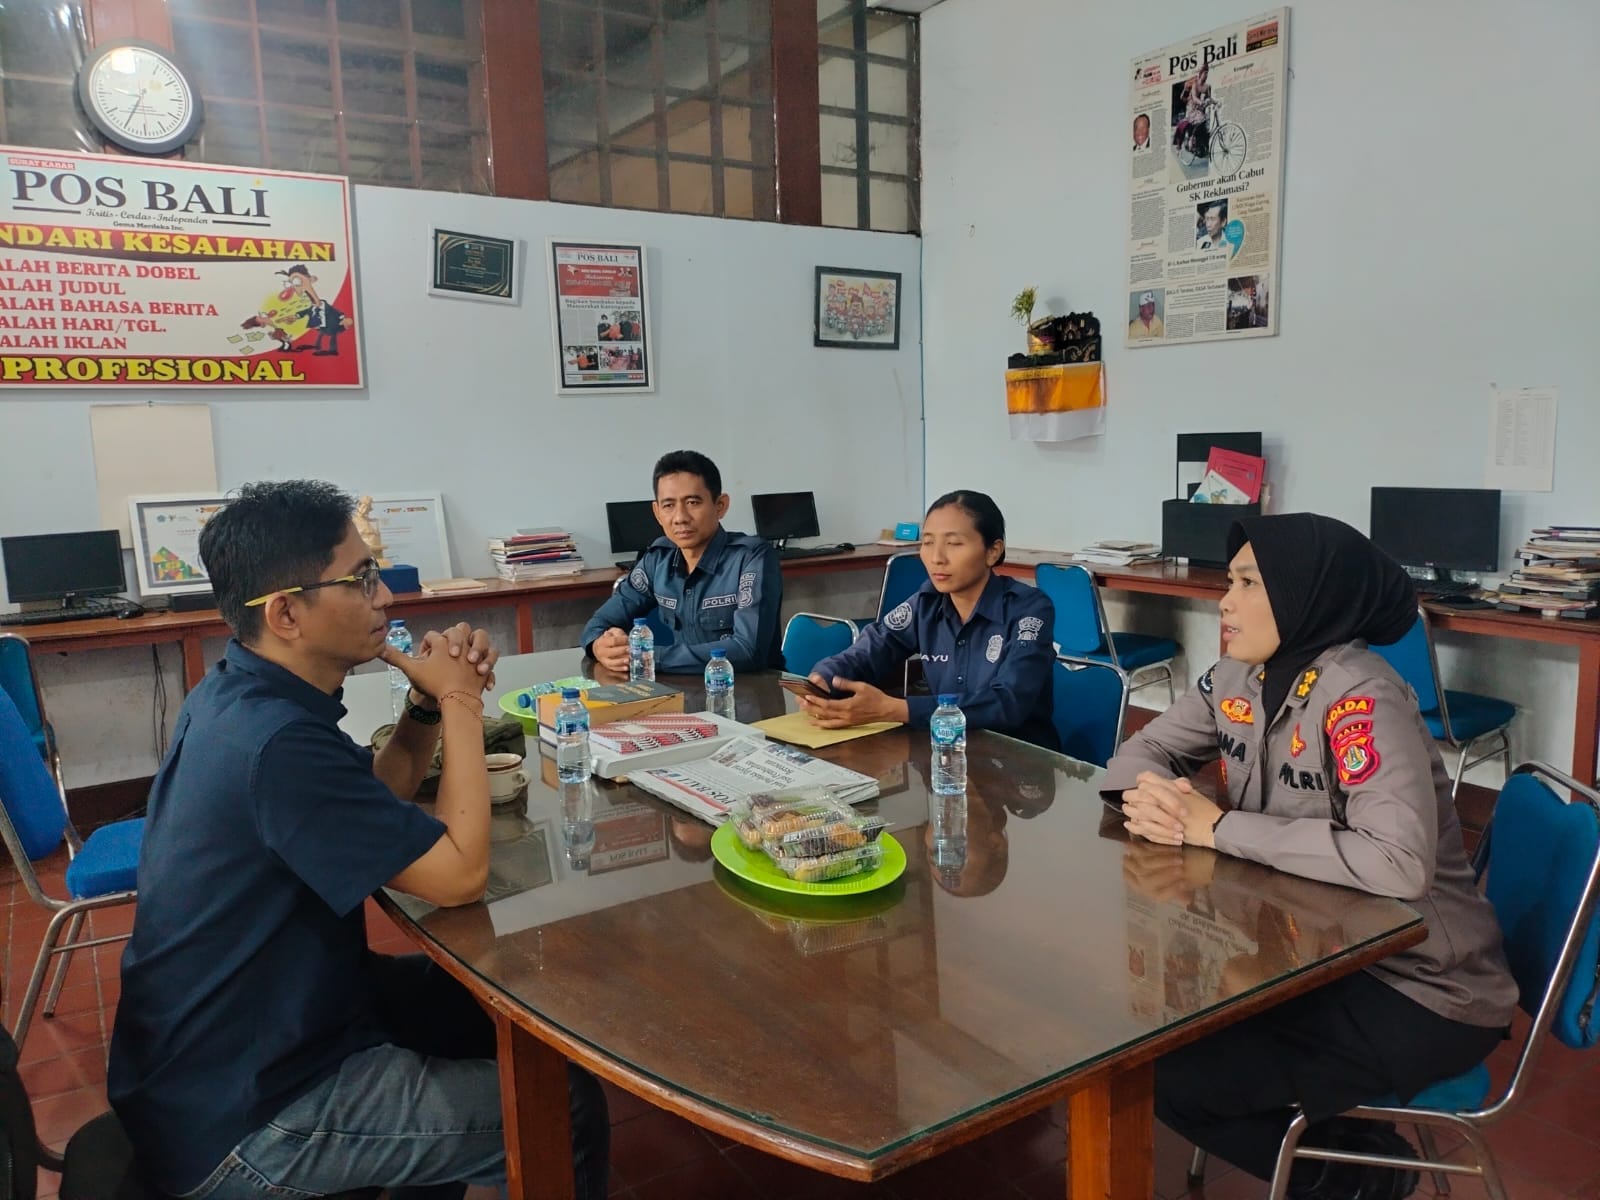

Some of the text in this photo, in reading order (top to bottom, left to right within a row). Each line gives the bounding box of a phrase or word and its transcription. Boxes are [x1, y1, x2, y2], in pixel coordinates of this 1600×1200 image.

[1169, 54, 1198, 76] Pos
[1203, 33, 1238, 64] Bali
[1176, 167, 1265, 193] Gubernur akan Cabut
[10, 169, 271, 217] POS BALI
[1189, 181, 1250, 202] SK Reklamasi?
[122, 231, 332, 262] KESALAHAN
[577, 253, 595, 261] POS
[56, 261, 130, 278] BERITA
[136, 264, 200, 280] DOBEL
[59, 281, 126, 297] JUDUL
[60, 298, 144, 314] BAHASA
[148, 301, 219, 317] BERITA
[62, 317, 167, 333] HARI/TGL.
[64, 336, 127, 350] IKLAN
[0, 355, 305, 382] PROFESIONAL
[704, 596, 735, 607] POLRI
[1337, 723, 1362, 740] BALI
